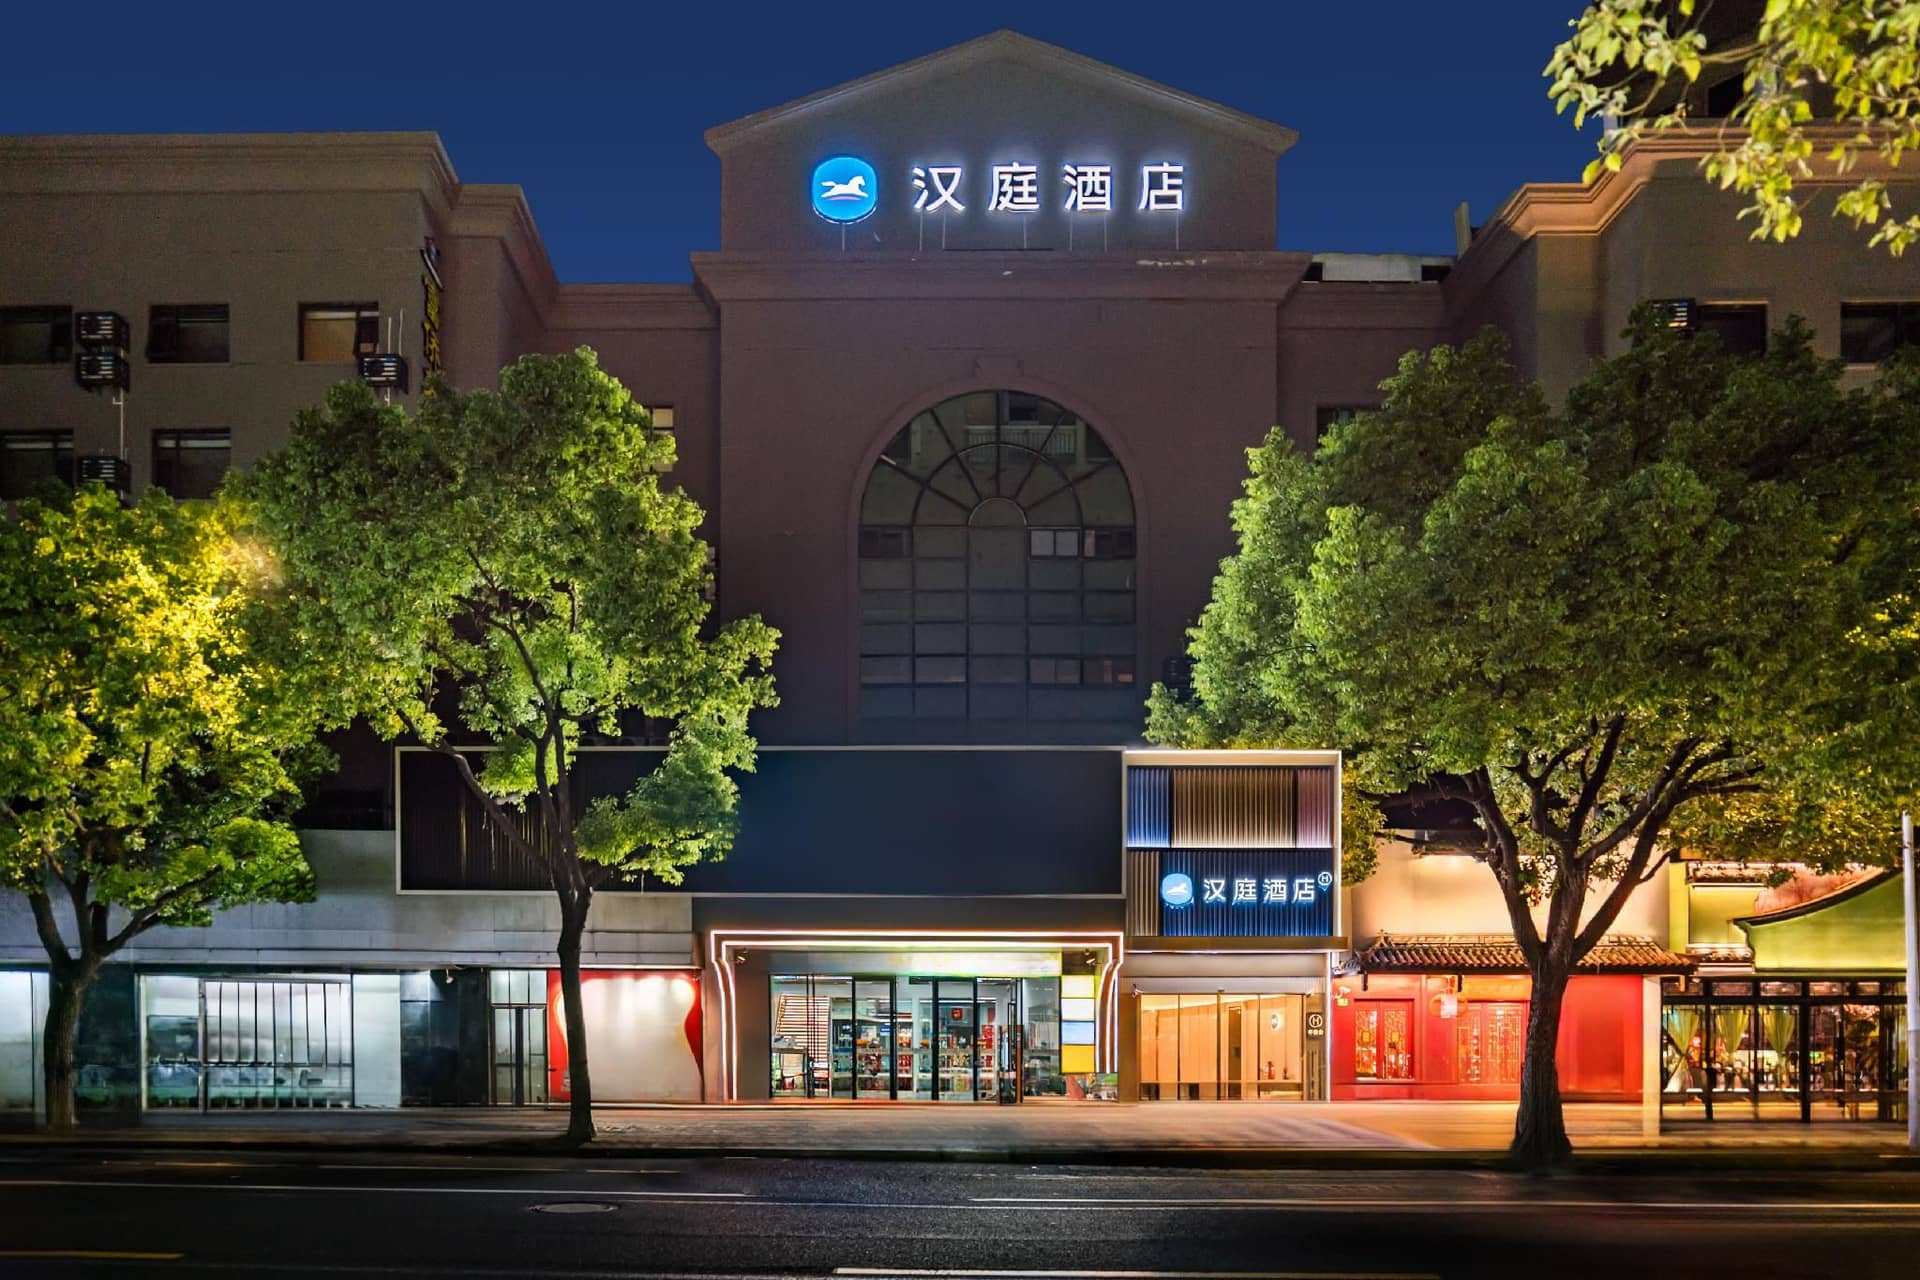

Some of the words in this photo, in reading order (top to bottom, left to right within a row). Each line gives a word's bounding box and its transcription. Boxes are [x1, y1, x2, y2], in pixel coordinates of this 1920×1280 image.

[912, 161, 1186, 212] 汉庭酒店
[1203, 877, 1315, 903] 汉庭酒店
